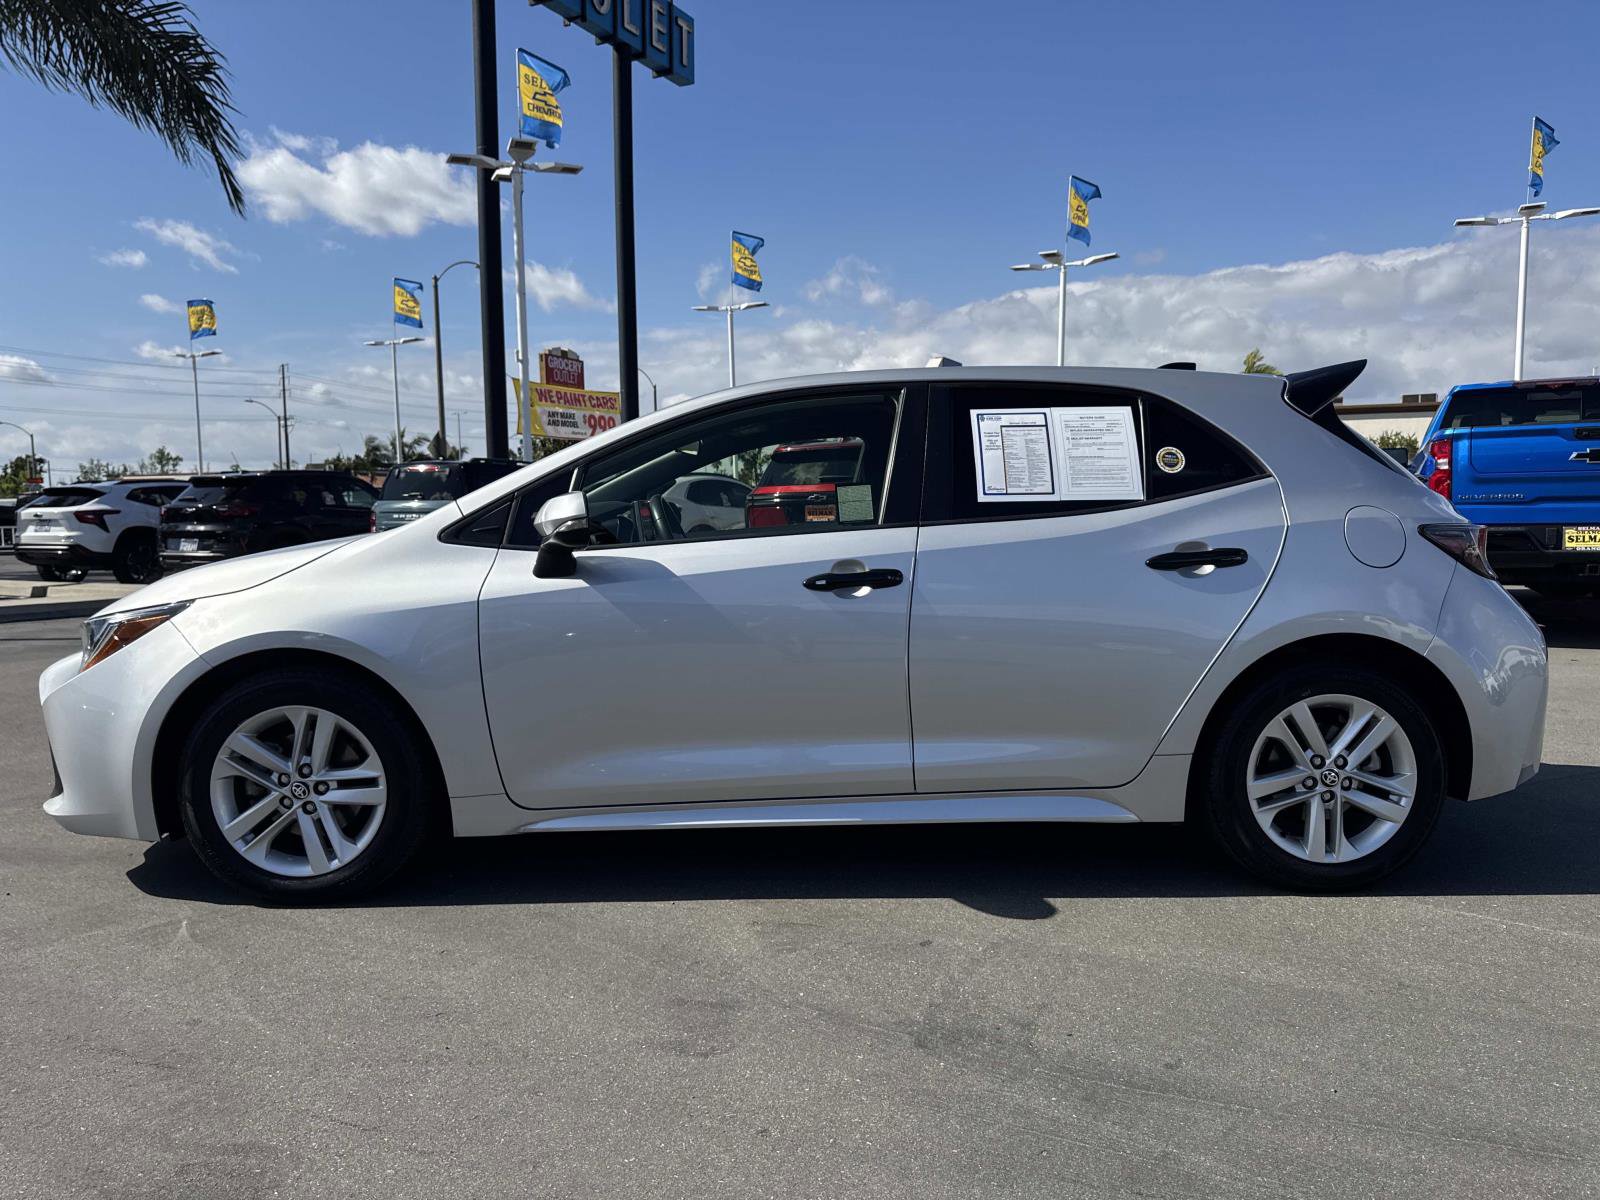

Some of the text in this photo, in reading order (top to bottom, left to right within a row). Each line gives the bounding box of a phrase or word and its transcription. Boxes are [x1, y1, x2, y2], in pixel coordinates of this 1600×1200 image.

[547, 355, 583, 374] GROCERY
[553, 369, 578, 385] OUTLET
[536, 388, 555, 404] WE
[555, 390, 587, 408] PAINT
[547, 411, 576, 421] ANY MAKE
[547, 419, 579, 429] AND MODEL
